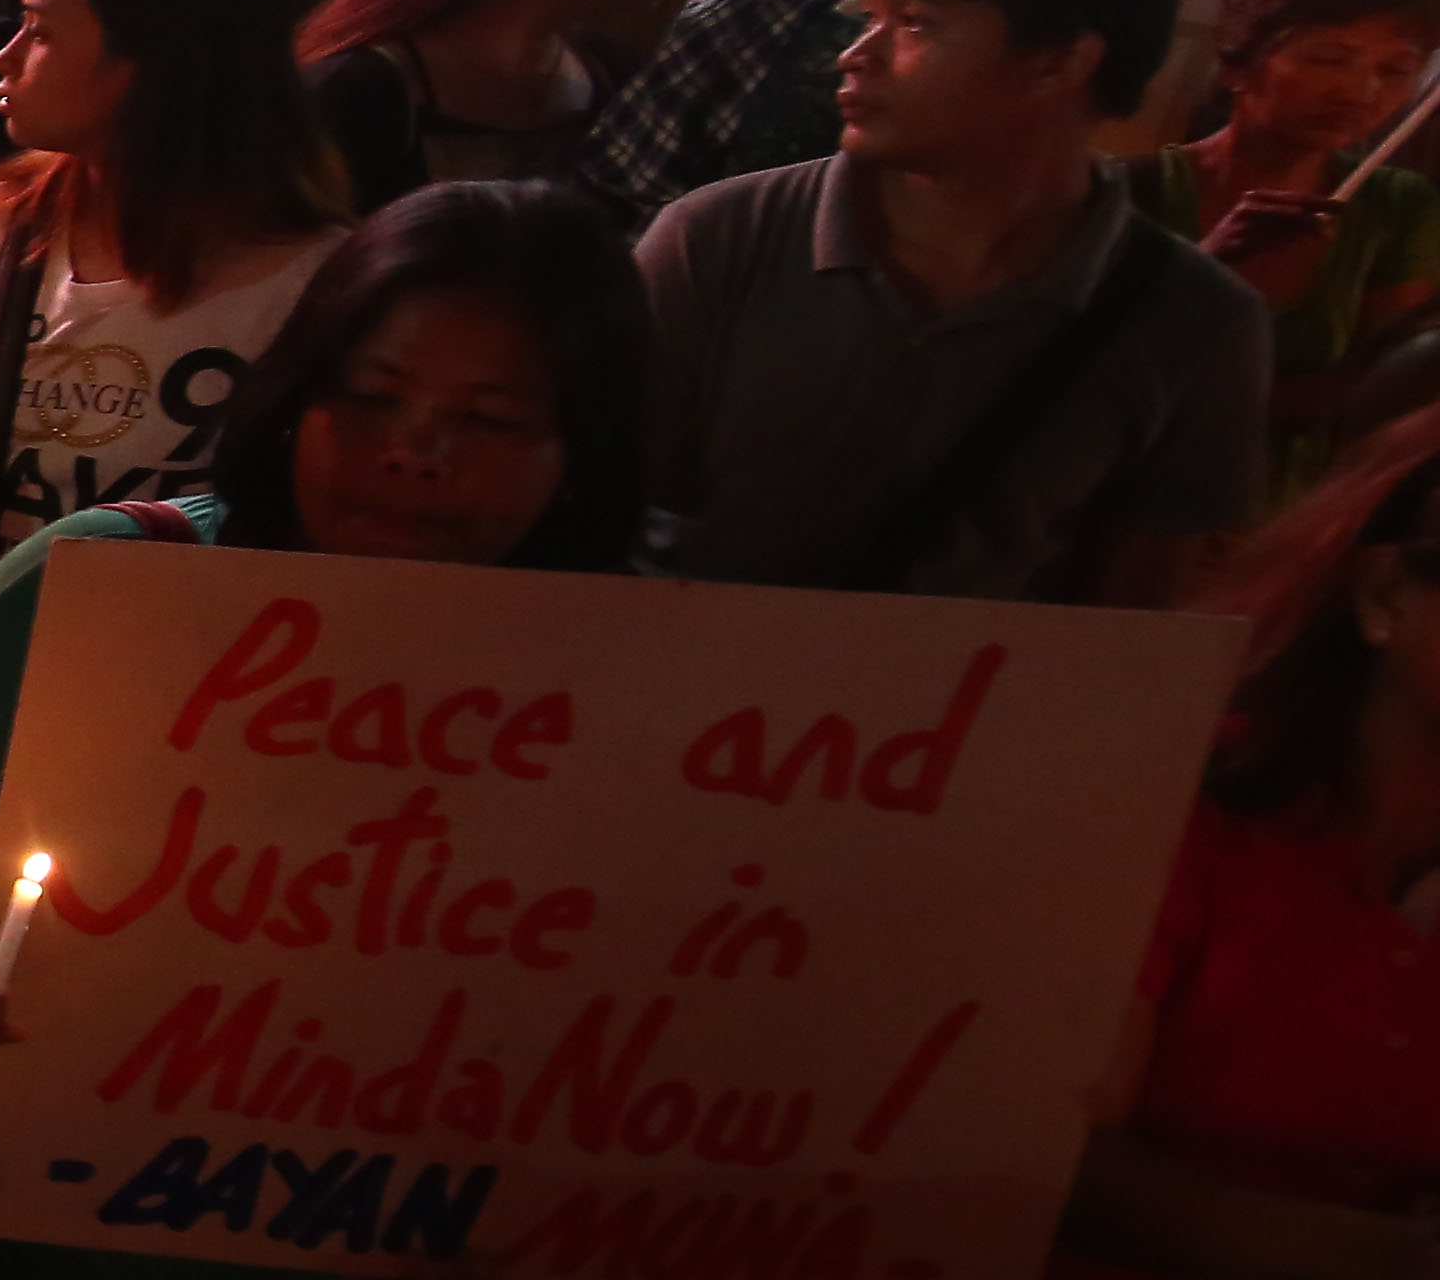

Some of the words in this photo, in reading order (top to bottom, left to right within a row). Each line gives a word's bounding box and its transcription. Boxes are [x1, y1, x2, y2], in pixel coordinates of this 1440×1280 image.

[16, 378, 153, 419] HANGE
[165, 596, 576, 782] Peace
[680, 641, 1010, 817] and
[42, 784, 600, 973] Justice
[666, 861, 813, 982] in
